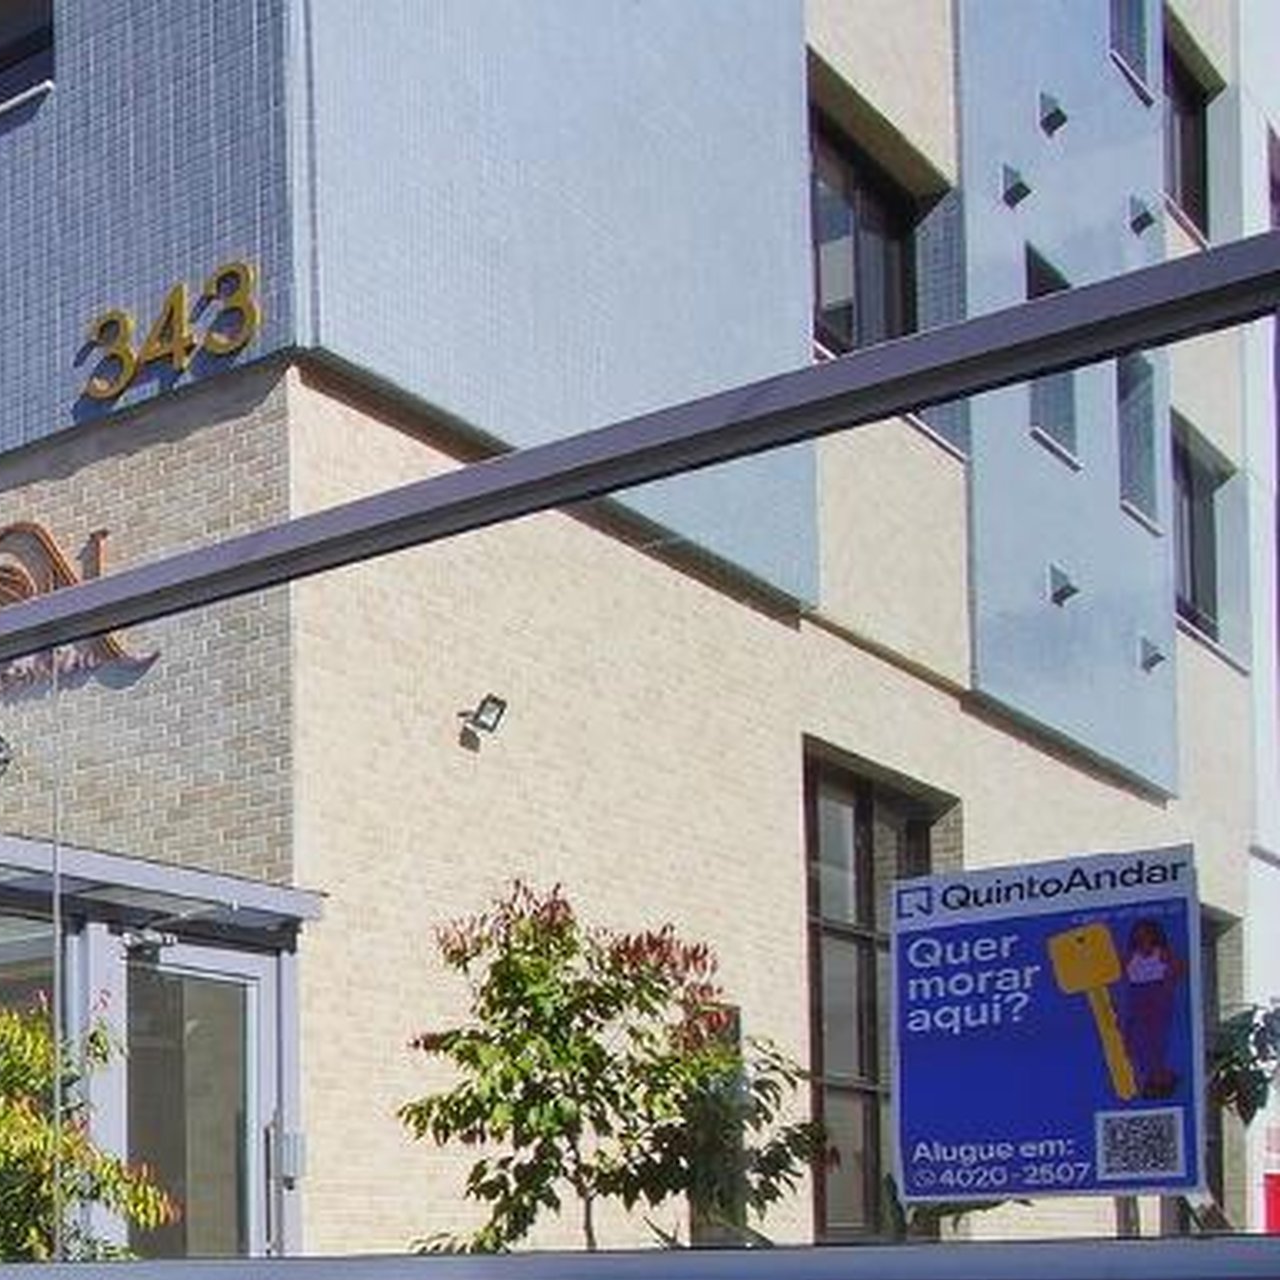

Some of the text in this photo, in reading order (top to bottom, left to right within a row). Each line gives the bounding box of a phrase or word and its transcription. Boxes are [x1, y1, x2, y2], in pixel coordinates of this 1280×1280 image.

[81, 261, 263, 400] 343
[940, 859, 1189, 910] QuintoAndar
[906, 933, 1020, 969] Quer
[906, 964, 1042, 1001] morar
[906, 992, 1029, 1034] aqui?
[912, 1138, 1075, 1166] Alugue em:
